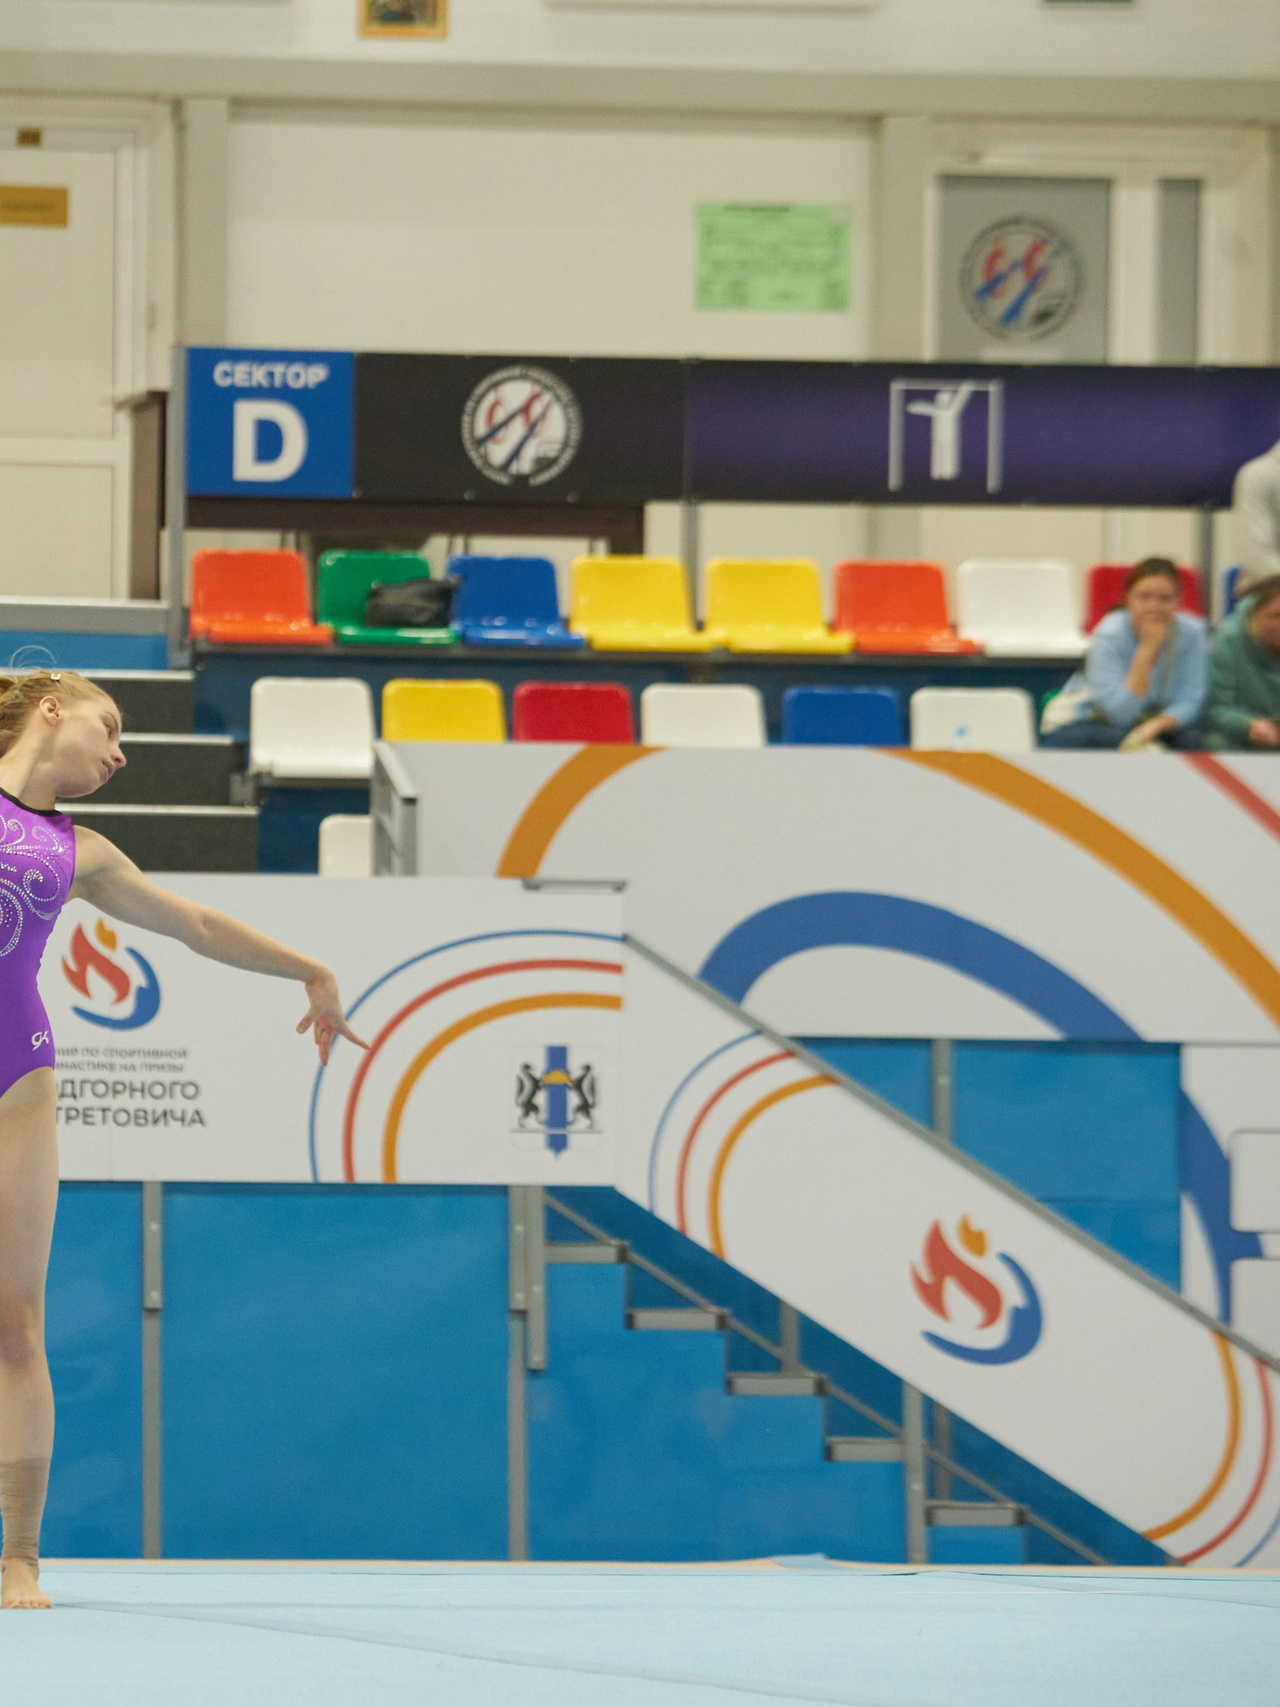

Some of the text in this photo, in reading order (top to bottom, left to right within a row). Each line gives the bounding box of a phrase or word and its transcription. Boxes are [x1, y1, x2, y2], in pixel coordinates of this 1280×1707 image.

[213, 361, 330, 388] СЕКТОР
[233, 398, 309, 482] D
[56, 1078, 201, 1101] ДГОРНОГО
